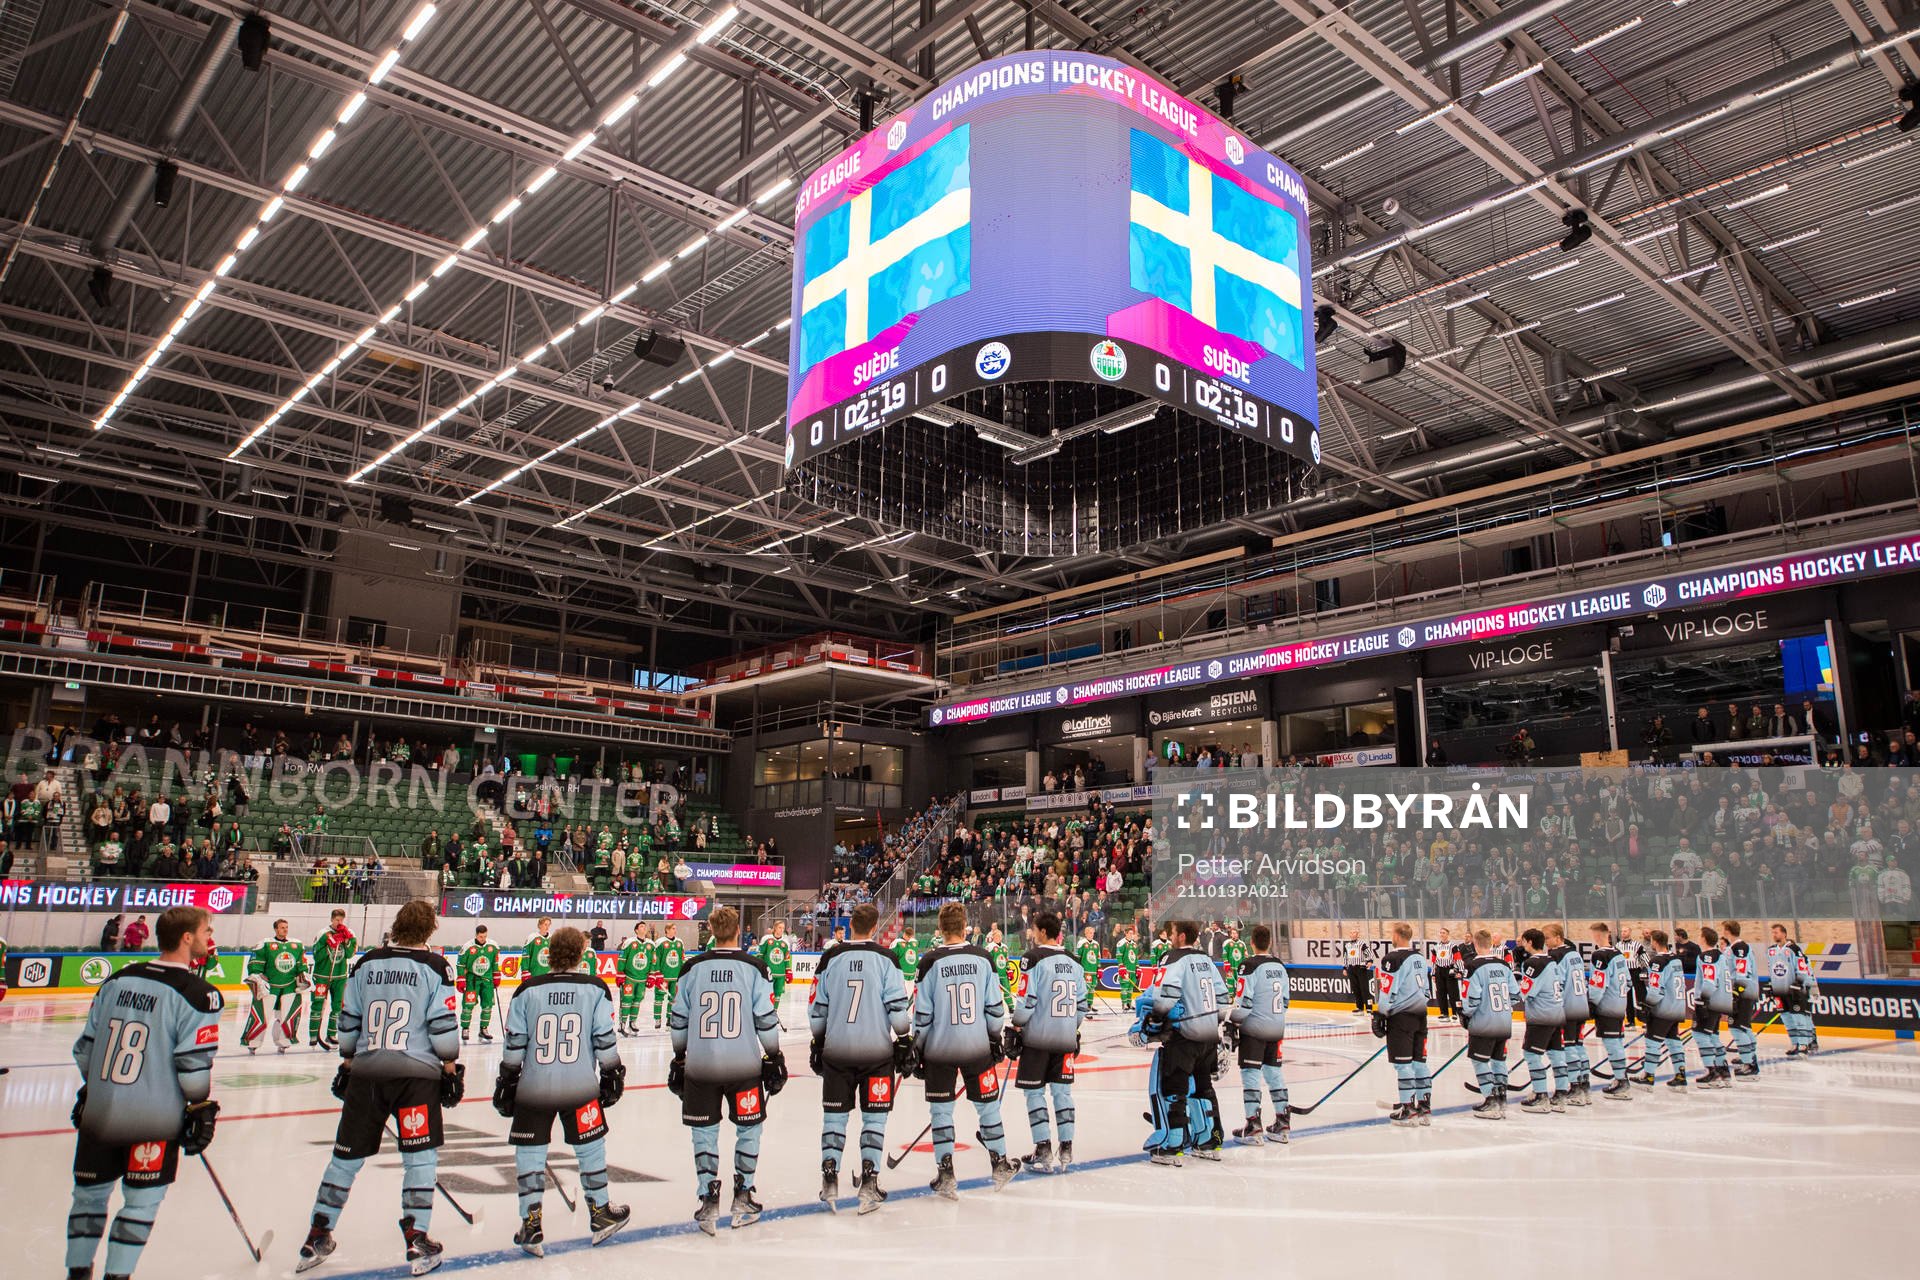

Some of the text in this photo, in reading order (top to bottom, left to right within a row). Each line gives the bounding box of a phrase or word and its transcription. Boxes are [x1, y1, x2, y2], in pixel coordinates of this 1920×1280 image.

[932, 61, 1198, 136] CHAMPIONS HOCKEY LEAGUE
[814, 151, 861, 198] LEAGUE
[853, 346, 900, 386] SUÈDE
[931, 364, 946, 393] 0
[1155, 363, 1171, 392] 0
[1203, 345, 1251, 384] SUÈDE
[844, 382, 906, 431] 02:19
[1195, 379, 1258, 428] 02:19
[810, 420, 823, 446] 0
[1280, 417, 1294, 444] 0
[1678, 566, 1785, 600] CHAMPIONS
[1789, 551, 1867, 582] HOCKEY
[1644, 584, 1666, 607] CHL
[1424, 592, 1632, 641] CHAMPIONS HOCKEY LEAGUE
[1664, 610, 1768, 642] VIP-LOGE
[1398, 627, 1416, 648] CHL
[1229, 633, 1389, 674] CHAMPIONS HOCKEY LEAGUE
[1468, 642, 1553, 670] VIP-LOGE
[1073, 666, 1201, 699] CHAMPIONS HOCKEY LEAGUE
[946, 702, 989, 720] CHAMPIONS
[989, 697, 1020, 713] HOCKEY
[1021, 692, 1051, 708] LEAGUE
[1210, 704, 1258, 718] RECYCLING
[1221, 690, 1257, 707] STENA
[1369, 752, 1392, 761] Lindab
[467, 773, 680, 827] CENTER
[567, 783, 580, 793] RH
[696, 868, 782, 881] CHAMPIONS HOCKEY LEAGUE
[38, 886, 119, 905] HOCKEY
[123, 888, 196, 907] LEAGUE
[208, 887, 233, 910] CHL
[493, 896, 674, 916] CHAMPIONS HOCKEY LEAGUE
[24, 962, 46, 983] CHL
[711, 970, 733, 983] ELLER
[796, 961, 818, 972] APK-
[116, 990, 158, 1013] HANSEN
[207, 991, 220, 1010] 18
[847, 979, 864, 1023] 7
[947, 982, 976, 1025] 19
[1051, 979, 1077, 1017] 25
[1272, 981, 1282, 1014] 2
[367, 999, 411, 1051] 92
[700, 990, 742, 1040] 20
[101, 1017, 150, 1085] 18
[535, 1012, 582, 1065] 93
[402, 1135, 431, 1147] STRAUSS
[579, 1124, 605, 1140] STRAUSS
[126, 1171, 160, 1180] STRAUSS
